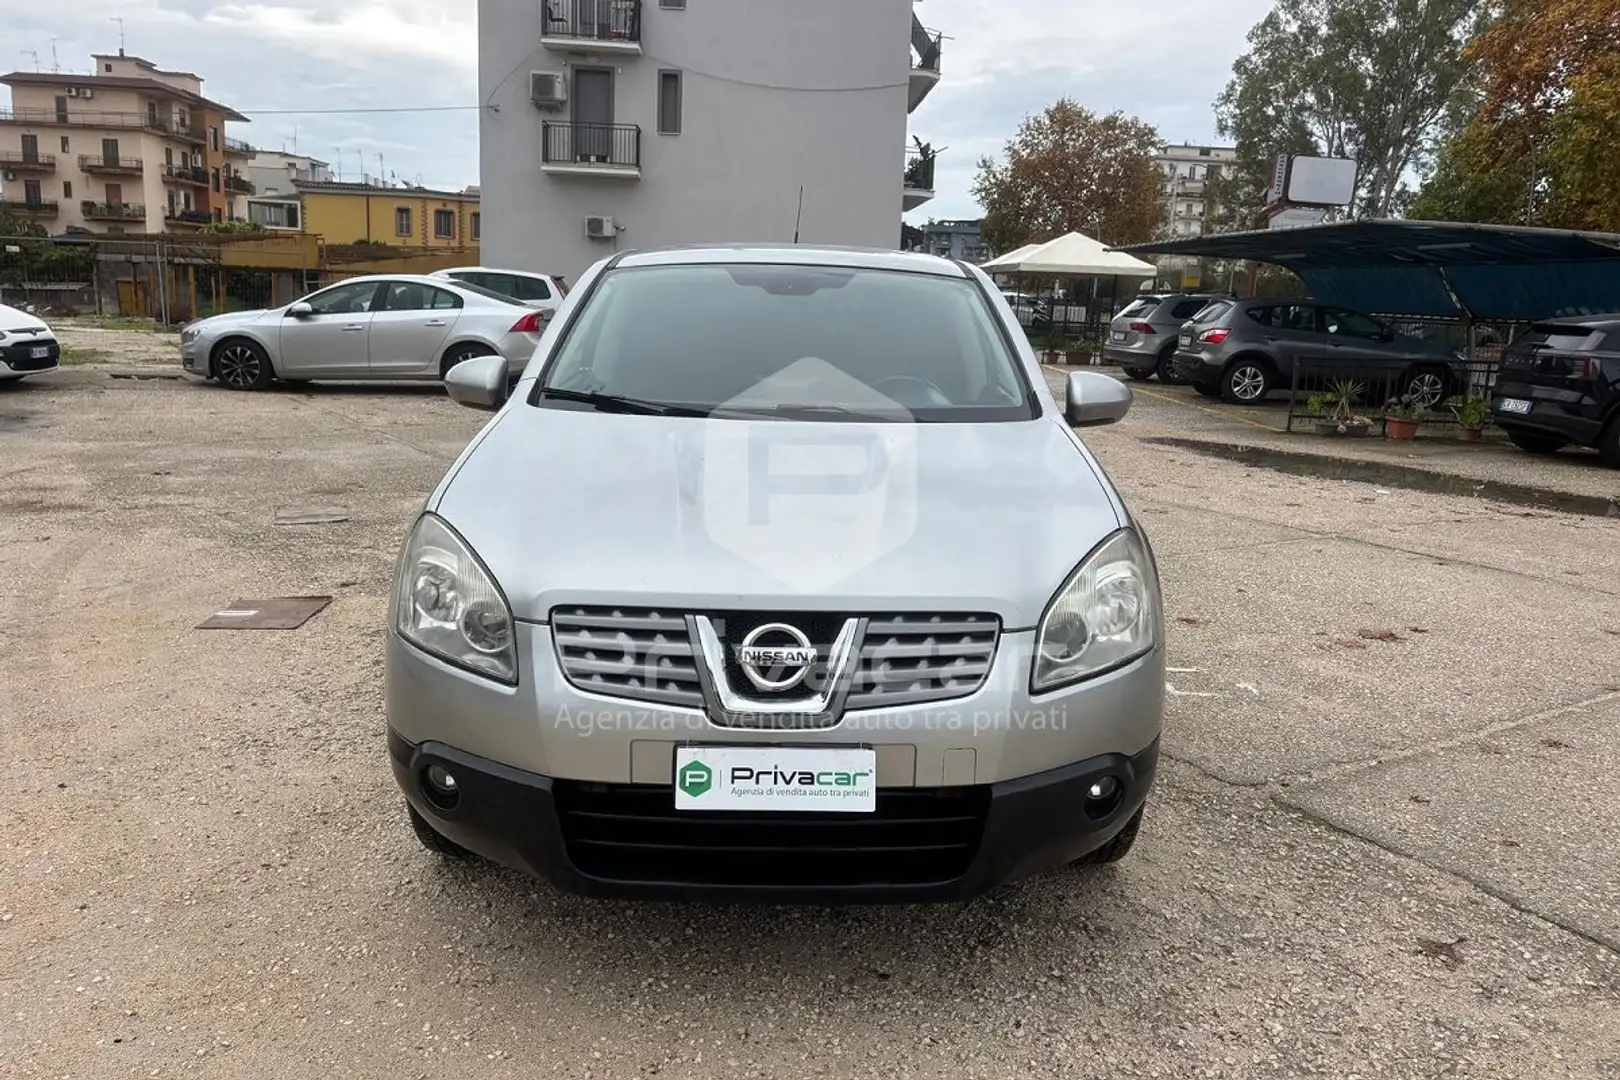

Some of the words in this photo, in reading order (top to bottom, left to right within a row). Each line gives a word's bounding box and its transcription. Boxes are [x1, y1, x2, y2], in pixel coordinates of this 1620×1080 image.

[744, 650, 809, 662] NISSAN
[684, 770, 709, 787] P
[730, 764, 870, 786] Privacar
[730, 786, 764, 798] Agenzia
[765, 786, 775, 796] di
[776, 787, 807, 797] vendita
[808, 788, 829, 797] auto
[829, 789, 841, 798] tra
[842, 788, 870, 799] privati
